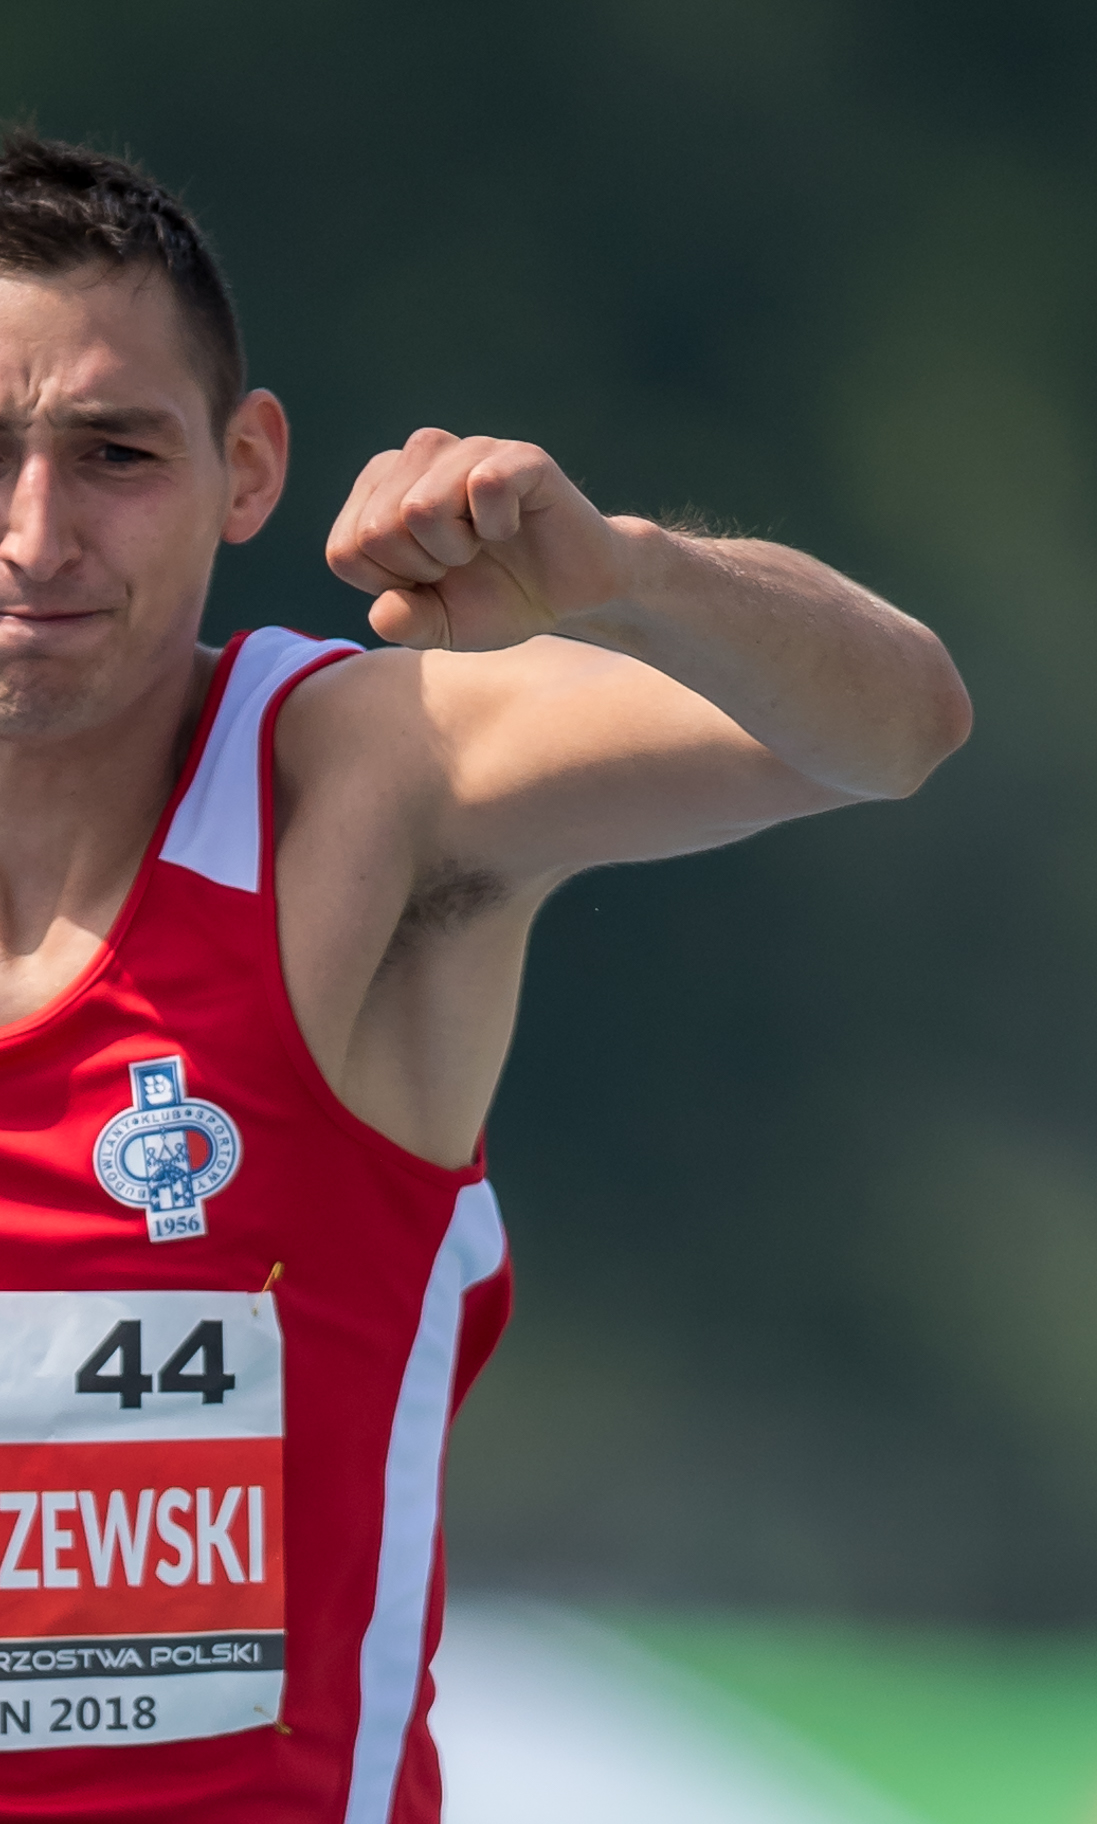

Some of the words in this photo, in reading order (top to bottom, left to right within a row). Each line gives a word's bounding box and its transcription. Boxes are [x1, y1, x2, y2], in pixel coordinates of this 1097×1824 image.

[102, 1120, 147, 1199] BUDOWLANY
[140, 1110, 181, 1125] KLUB
[194, 1109, 231, 1190] SPORTOWY
[154, 1213, 201, 1238] 1956
[74, 1319, 236, 1409] 44
[150, 1642, 263, 1668] POLSKI
[49, 1696, 157, 1732] 2018
